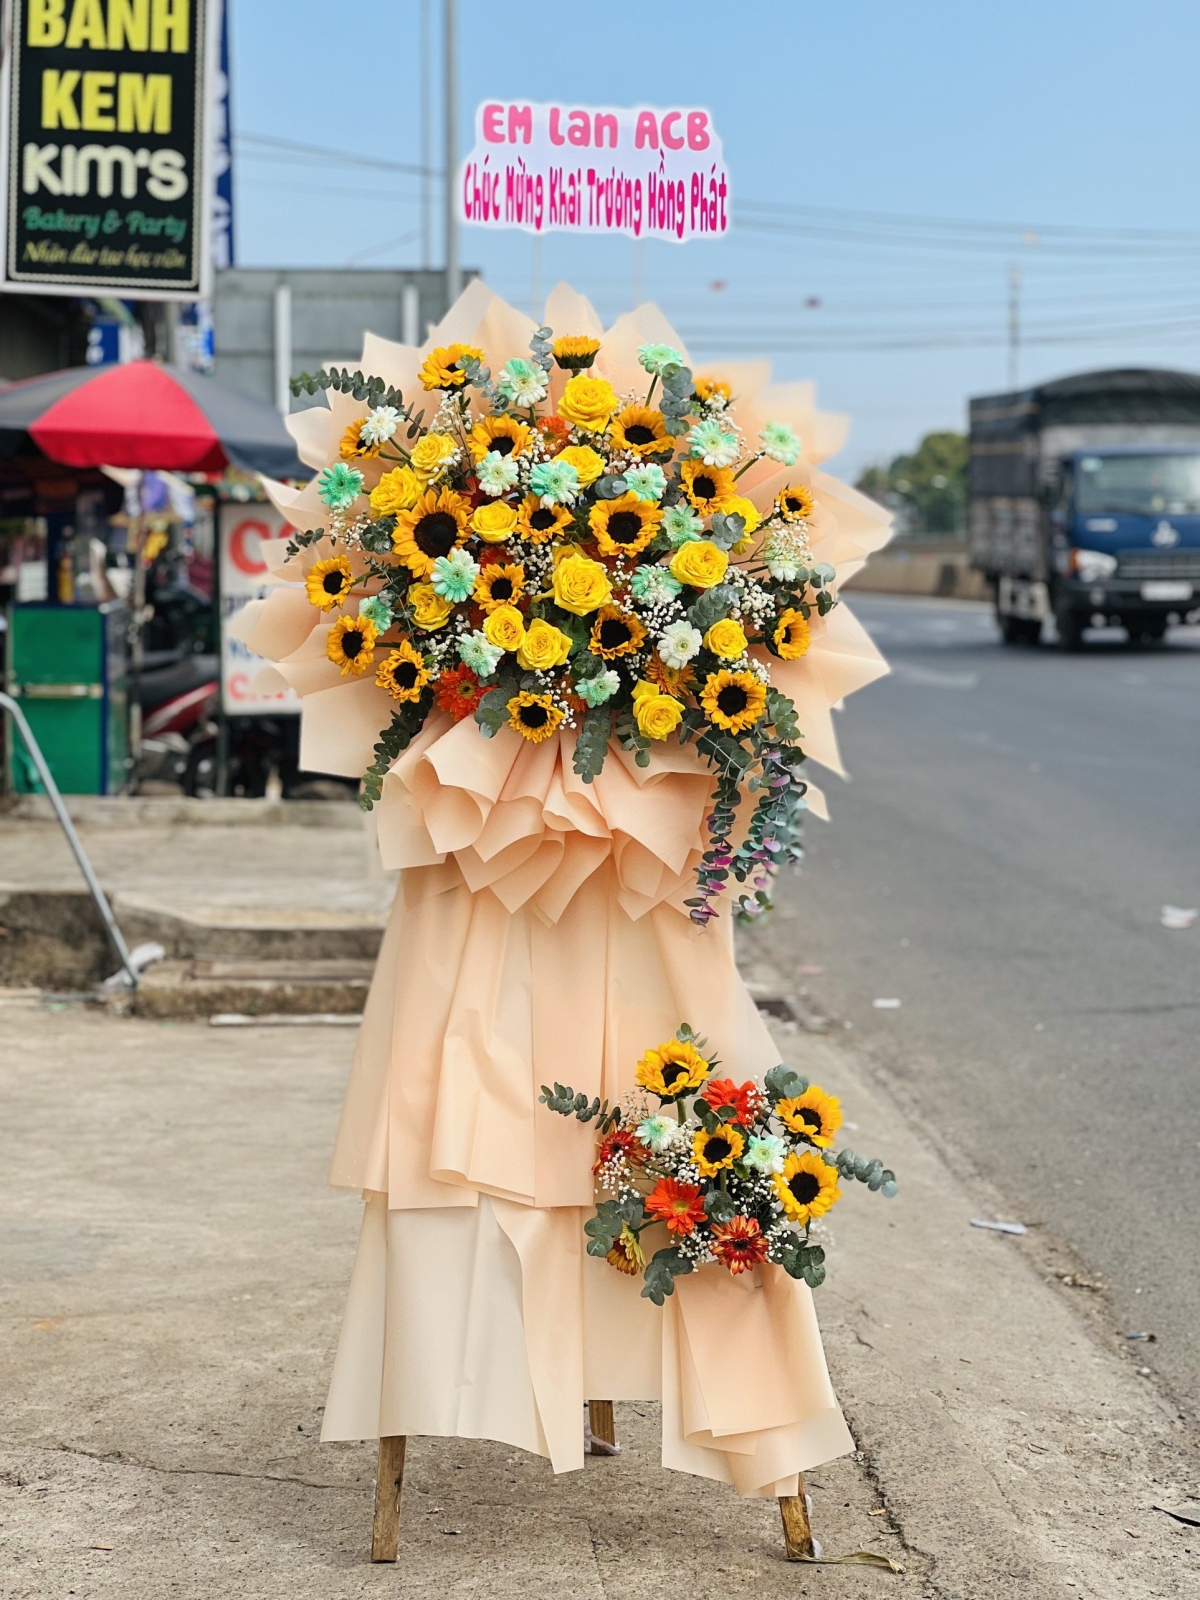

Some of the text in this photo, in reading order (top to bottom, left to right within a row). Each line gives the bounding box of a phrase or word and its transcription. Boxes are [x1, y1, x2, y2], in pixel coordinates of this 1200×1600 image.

[41, 69, 172, 134] KEM
[482, 104, 532, 144] EM
[634, 111, 710, 151] ACB
[464, 148, 727, 239] Chúc Mừng Khai Trương Hồng Phát
[22, 205, 187, 244] Bakery & Party
